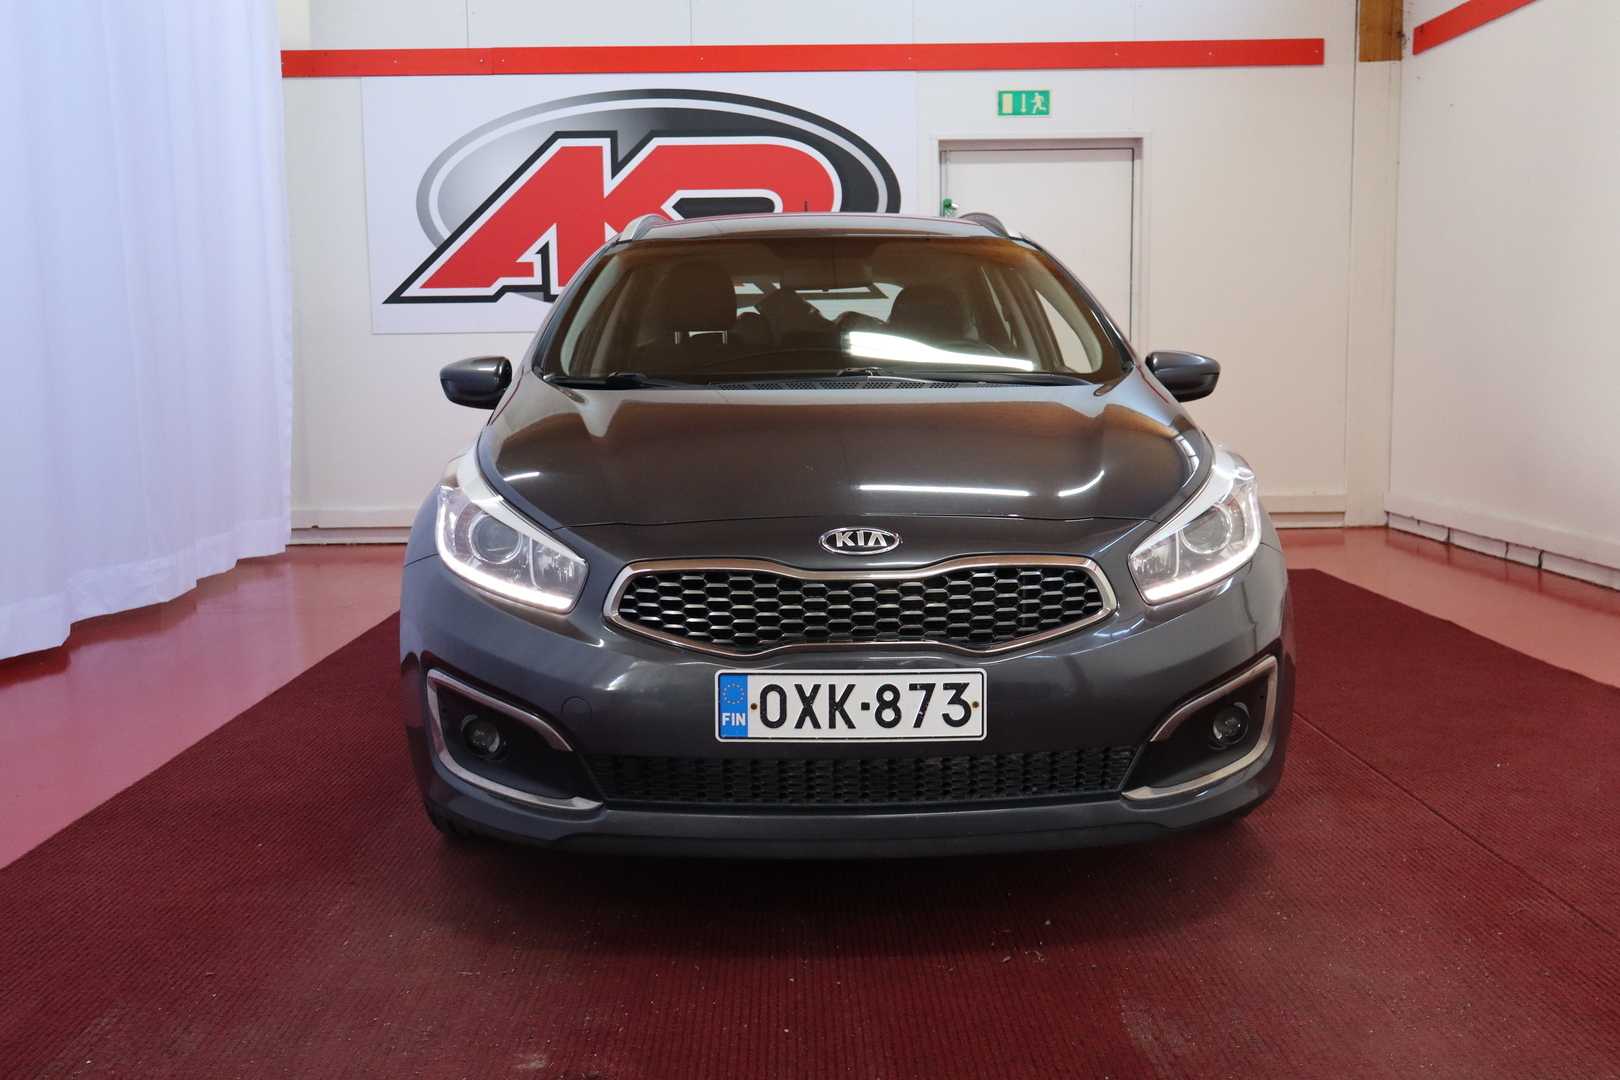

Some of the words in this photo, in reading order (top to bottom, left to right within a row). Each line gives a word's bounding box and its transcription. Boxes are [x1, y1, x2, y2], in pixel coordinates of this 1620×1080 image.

[835, 530, 888, 547] KIA
[759, 682, 972, 729] OXK-873
[721, 712, 747, 726] FIN
